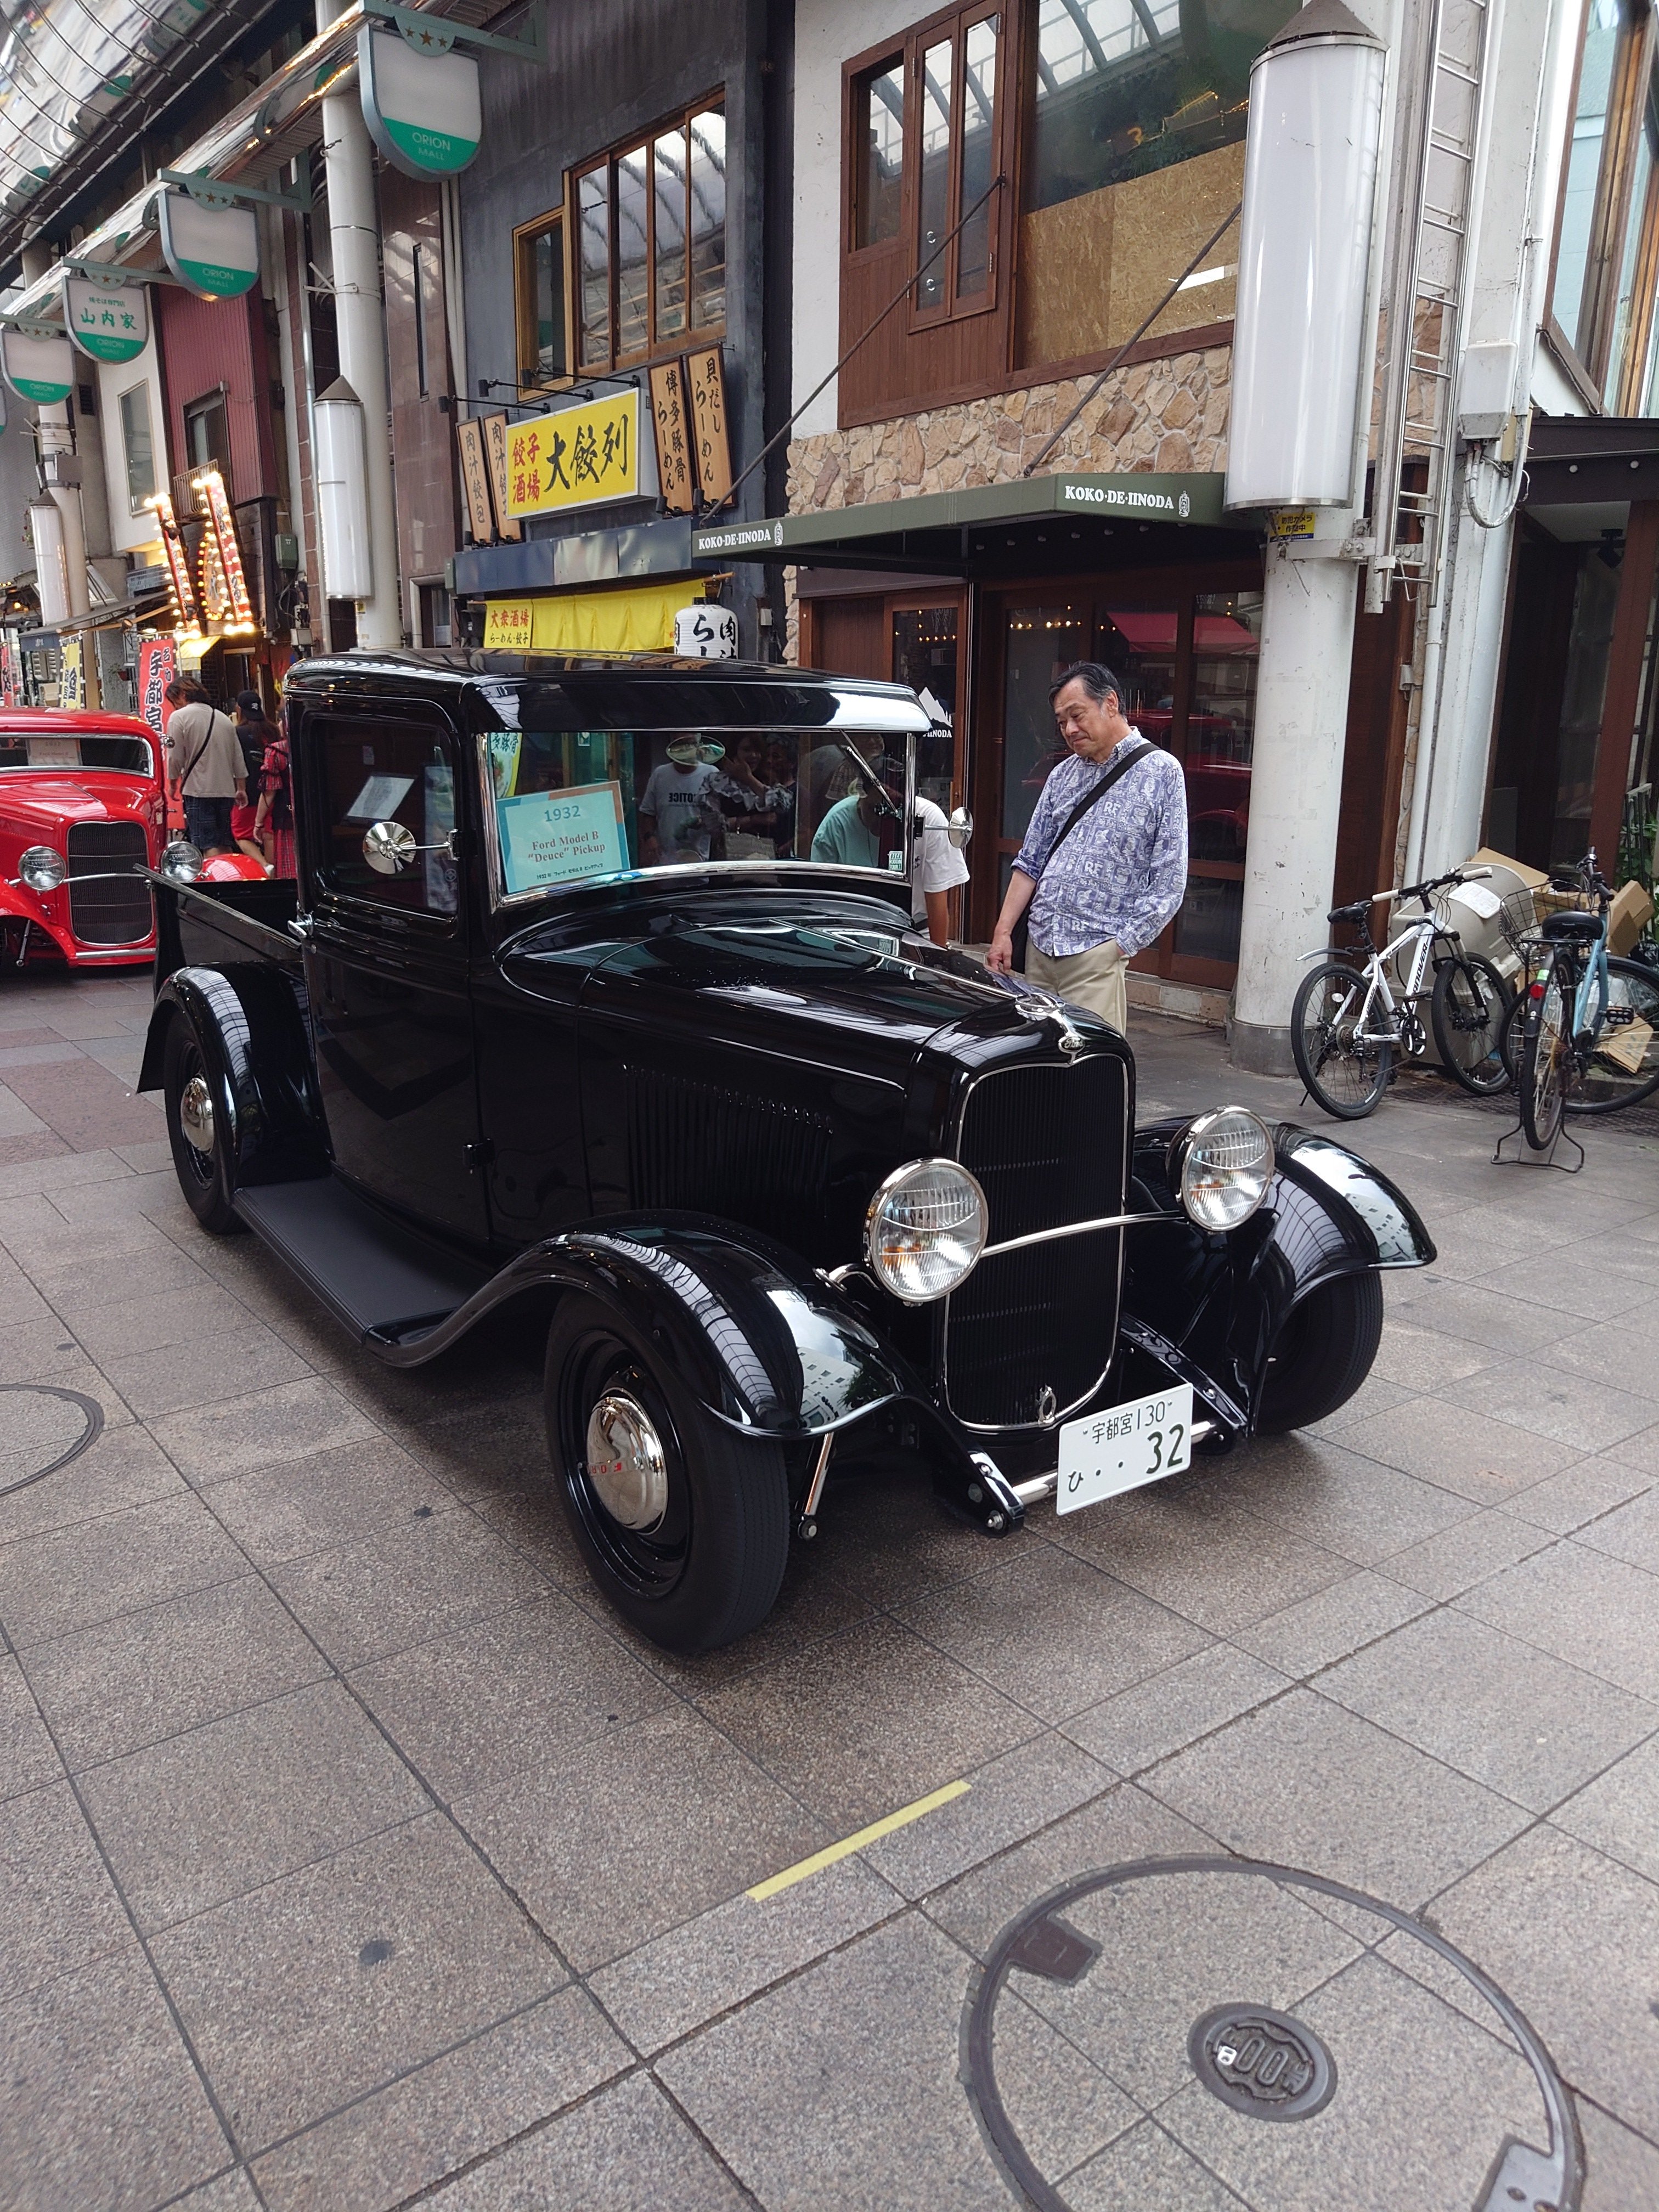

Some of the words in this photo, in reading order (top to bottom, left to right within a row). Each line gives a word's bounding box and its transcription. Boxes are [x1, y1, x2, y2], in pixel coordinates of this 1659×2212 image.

[412, 132, 450, 151] ORION
[419, 147, 445, 160] MALL
[202, 267, 234, 280] ORION
[208, 279, 229, 288] MALL
[81, 307, 138, 329] 山内家
[97, 338, 125, 349] ORION
[30, 383, 54, 392] ORION
[706, 357, 720, 433] 貝だし
[665, 369, 686, 483] 博多豚骨
[696, 381, 714, 482] らーめん
[512, 432, 540, 469] 餃子
[544, 414, 629, 493] 大餃列
[658, 401, 674, 490] らーめん
[512, 469, 540, 504] 酒場
[490, 608, 529, 628] 大衆酒場
[145, 650, 164, 733] 宇都宮
[922, 729, 952, 738] IINODA
[544, 805, 580, 822] 1932
[532, 839, 556, 850] Ford
[559, 832, 589, 845] Model
[592, 831, 599, 839] B
[573, 843, 605, 856] Pickup
[1412, 943, 1429, 992] ANOVER
[1064, 1039, 1084, 1049] Ford
[1068, 1471, 1084, 1492] ひ
